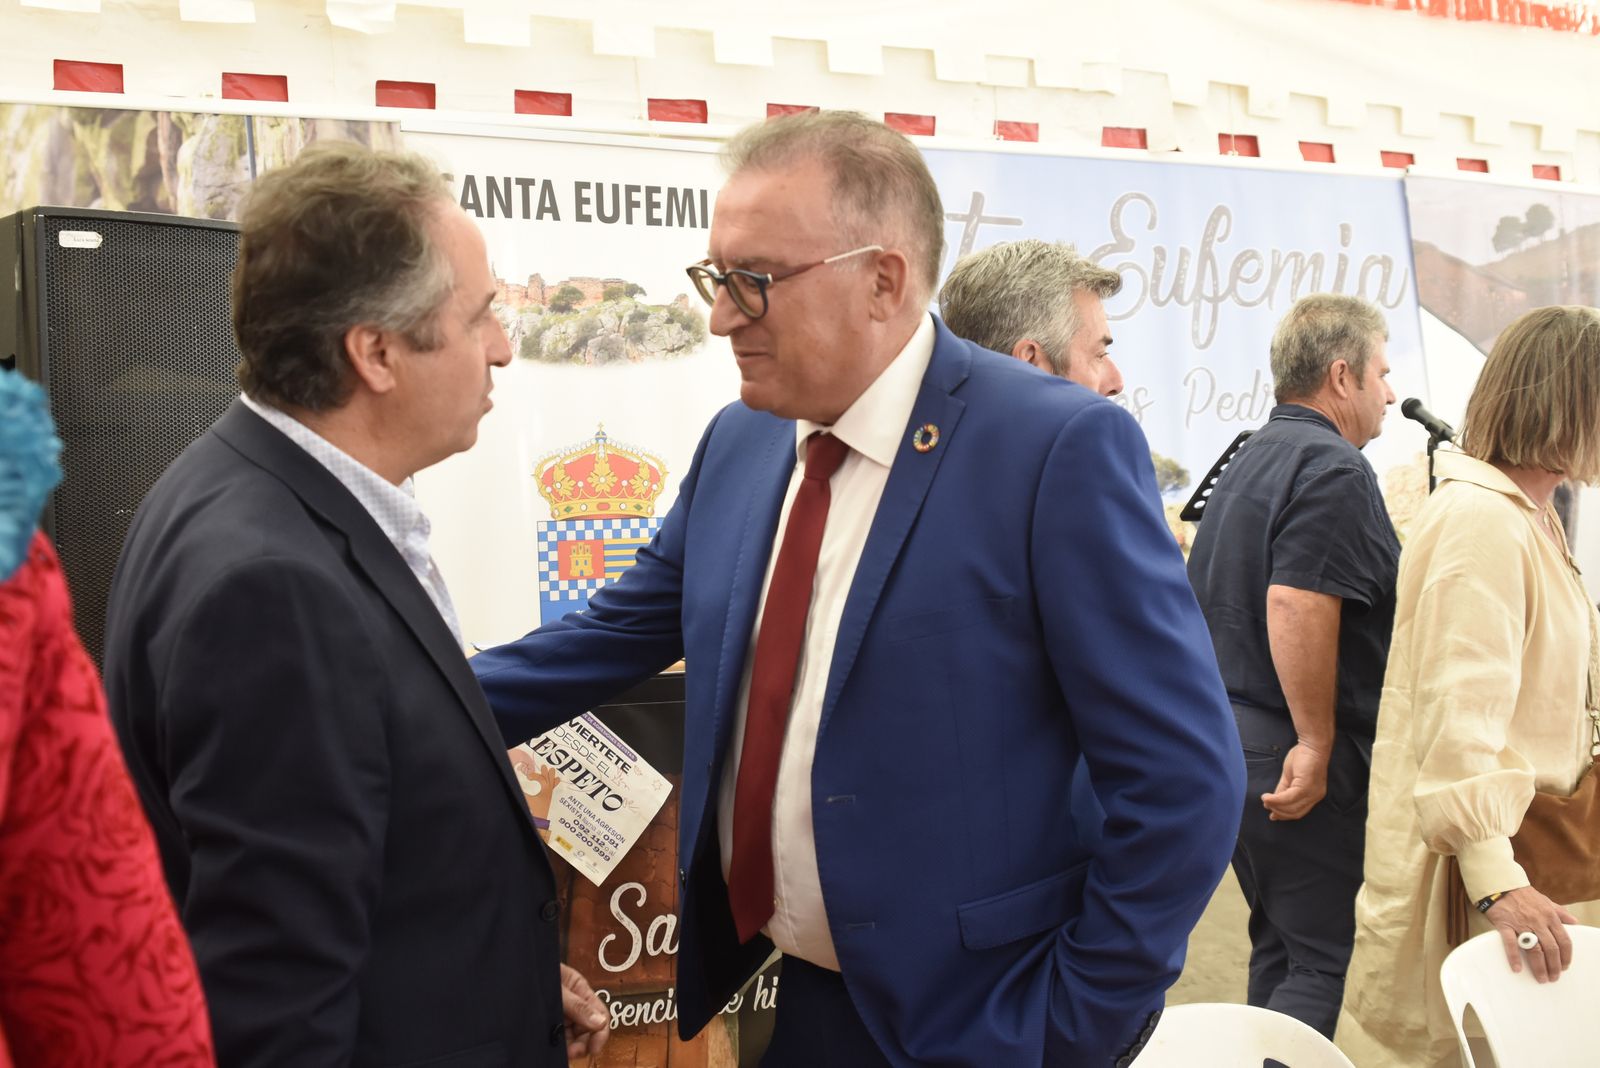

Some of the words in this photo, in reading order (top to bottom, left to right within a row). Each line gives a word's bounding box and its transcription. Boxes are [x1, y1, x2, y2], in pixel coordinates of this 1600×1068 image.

[444, 173, 561, 222] ANTA
[1088, 192, 1410, 350] Eufemia
[553, 727, 598, 764] DESDE
[597, 761, 611, 777] EL
[559, 798, 582, 819] SEXISTA
[603, 834, 619, 849] 091
[568, 796, 584, 810] ANTE
[583, 808, 596, 820] UNA
[558, 818, 576, 833] 900
[576, 832, 593, 847] 200
[593, 846, 610, 862] 999
[573, 819, 590, 835] 092
[590, 834, 606, 848] 112
